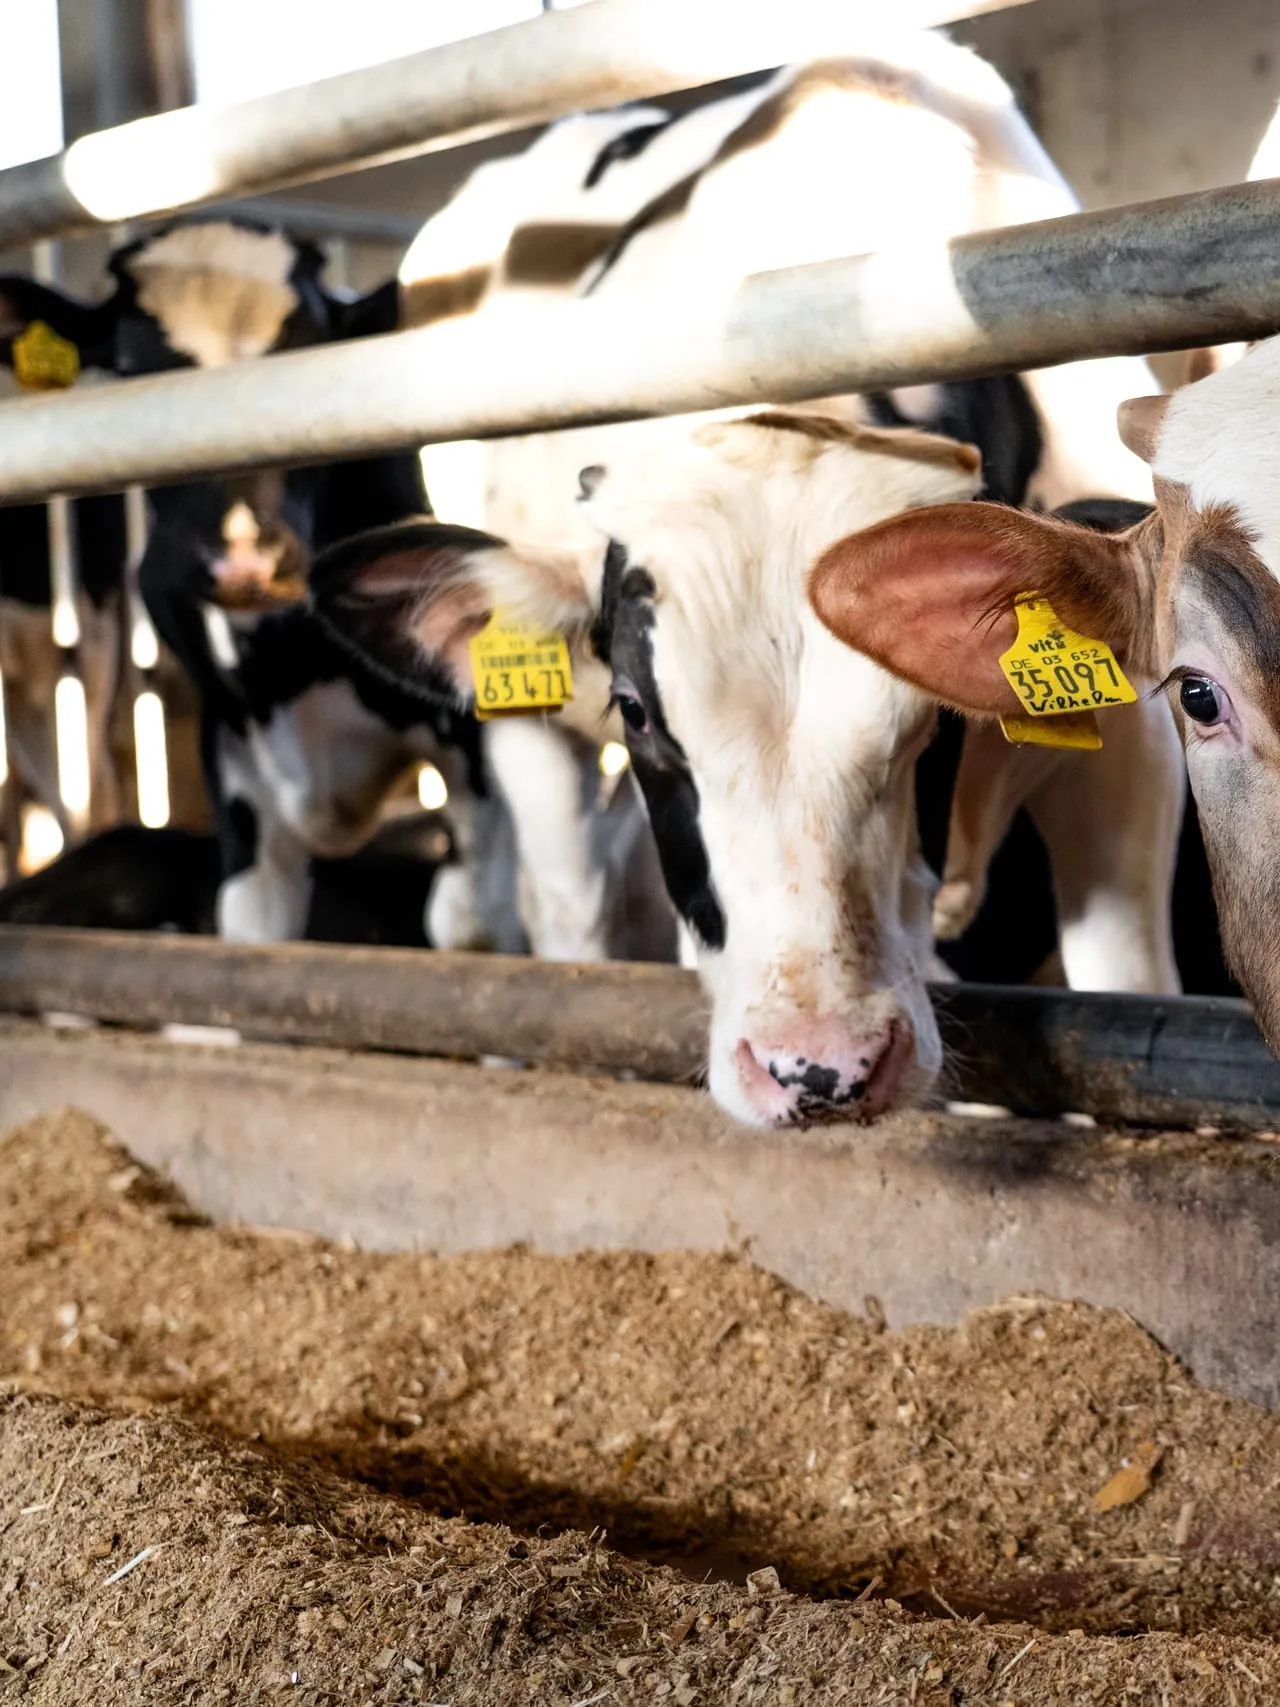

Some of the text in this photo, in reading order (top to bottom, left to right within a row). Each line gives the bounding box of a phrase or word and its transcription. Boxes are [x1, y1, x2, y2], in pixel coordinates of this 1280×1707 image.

[1010, 648, 1101, 671] DE 03 652
[1010, 657, 1119, 700] 35097
